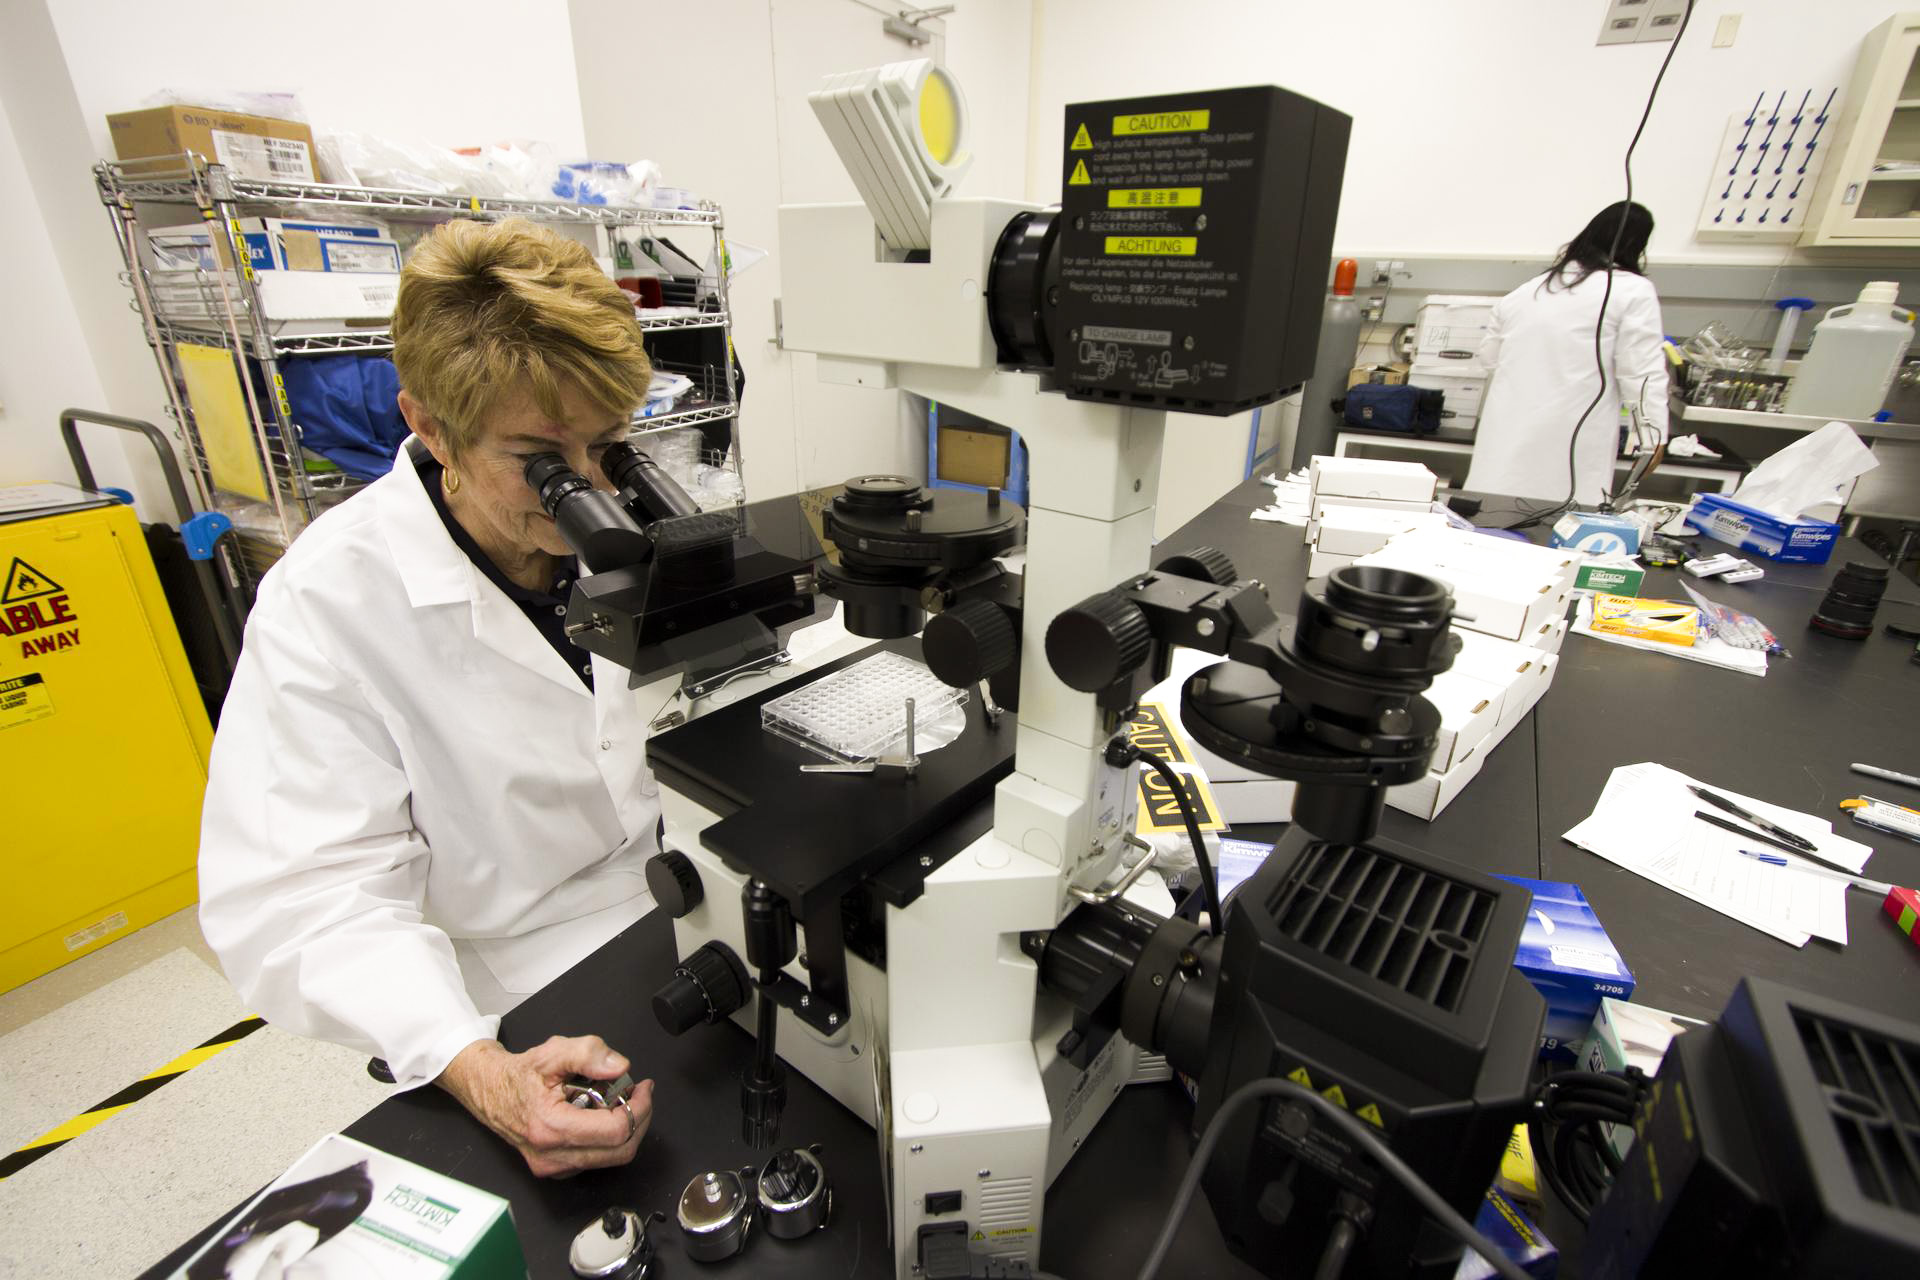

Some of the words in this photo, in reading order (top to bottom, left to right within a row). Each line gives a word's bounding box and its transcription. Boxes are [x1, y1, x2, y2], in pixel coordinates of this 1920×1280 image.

[1129, 114, 1192, 132] CAUTION
[1117, 239, 1182, 254] ACHTUNG
[1091, 293, 1133, 304] OLYMPUS
[1715, 513, 1750, 532] Kimwipes
[1791, 532, 1832, 542] Kimwipes
[21, 627, 80, 659] AWAY
[1129, 710, 1199, 816] CAUTON
[1593, 983, 1624, 994] 34705
[383, 1188, 457, 1228] KIMTECH
